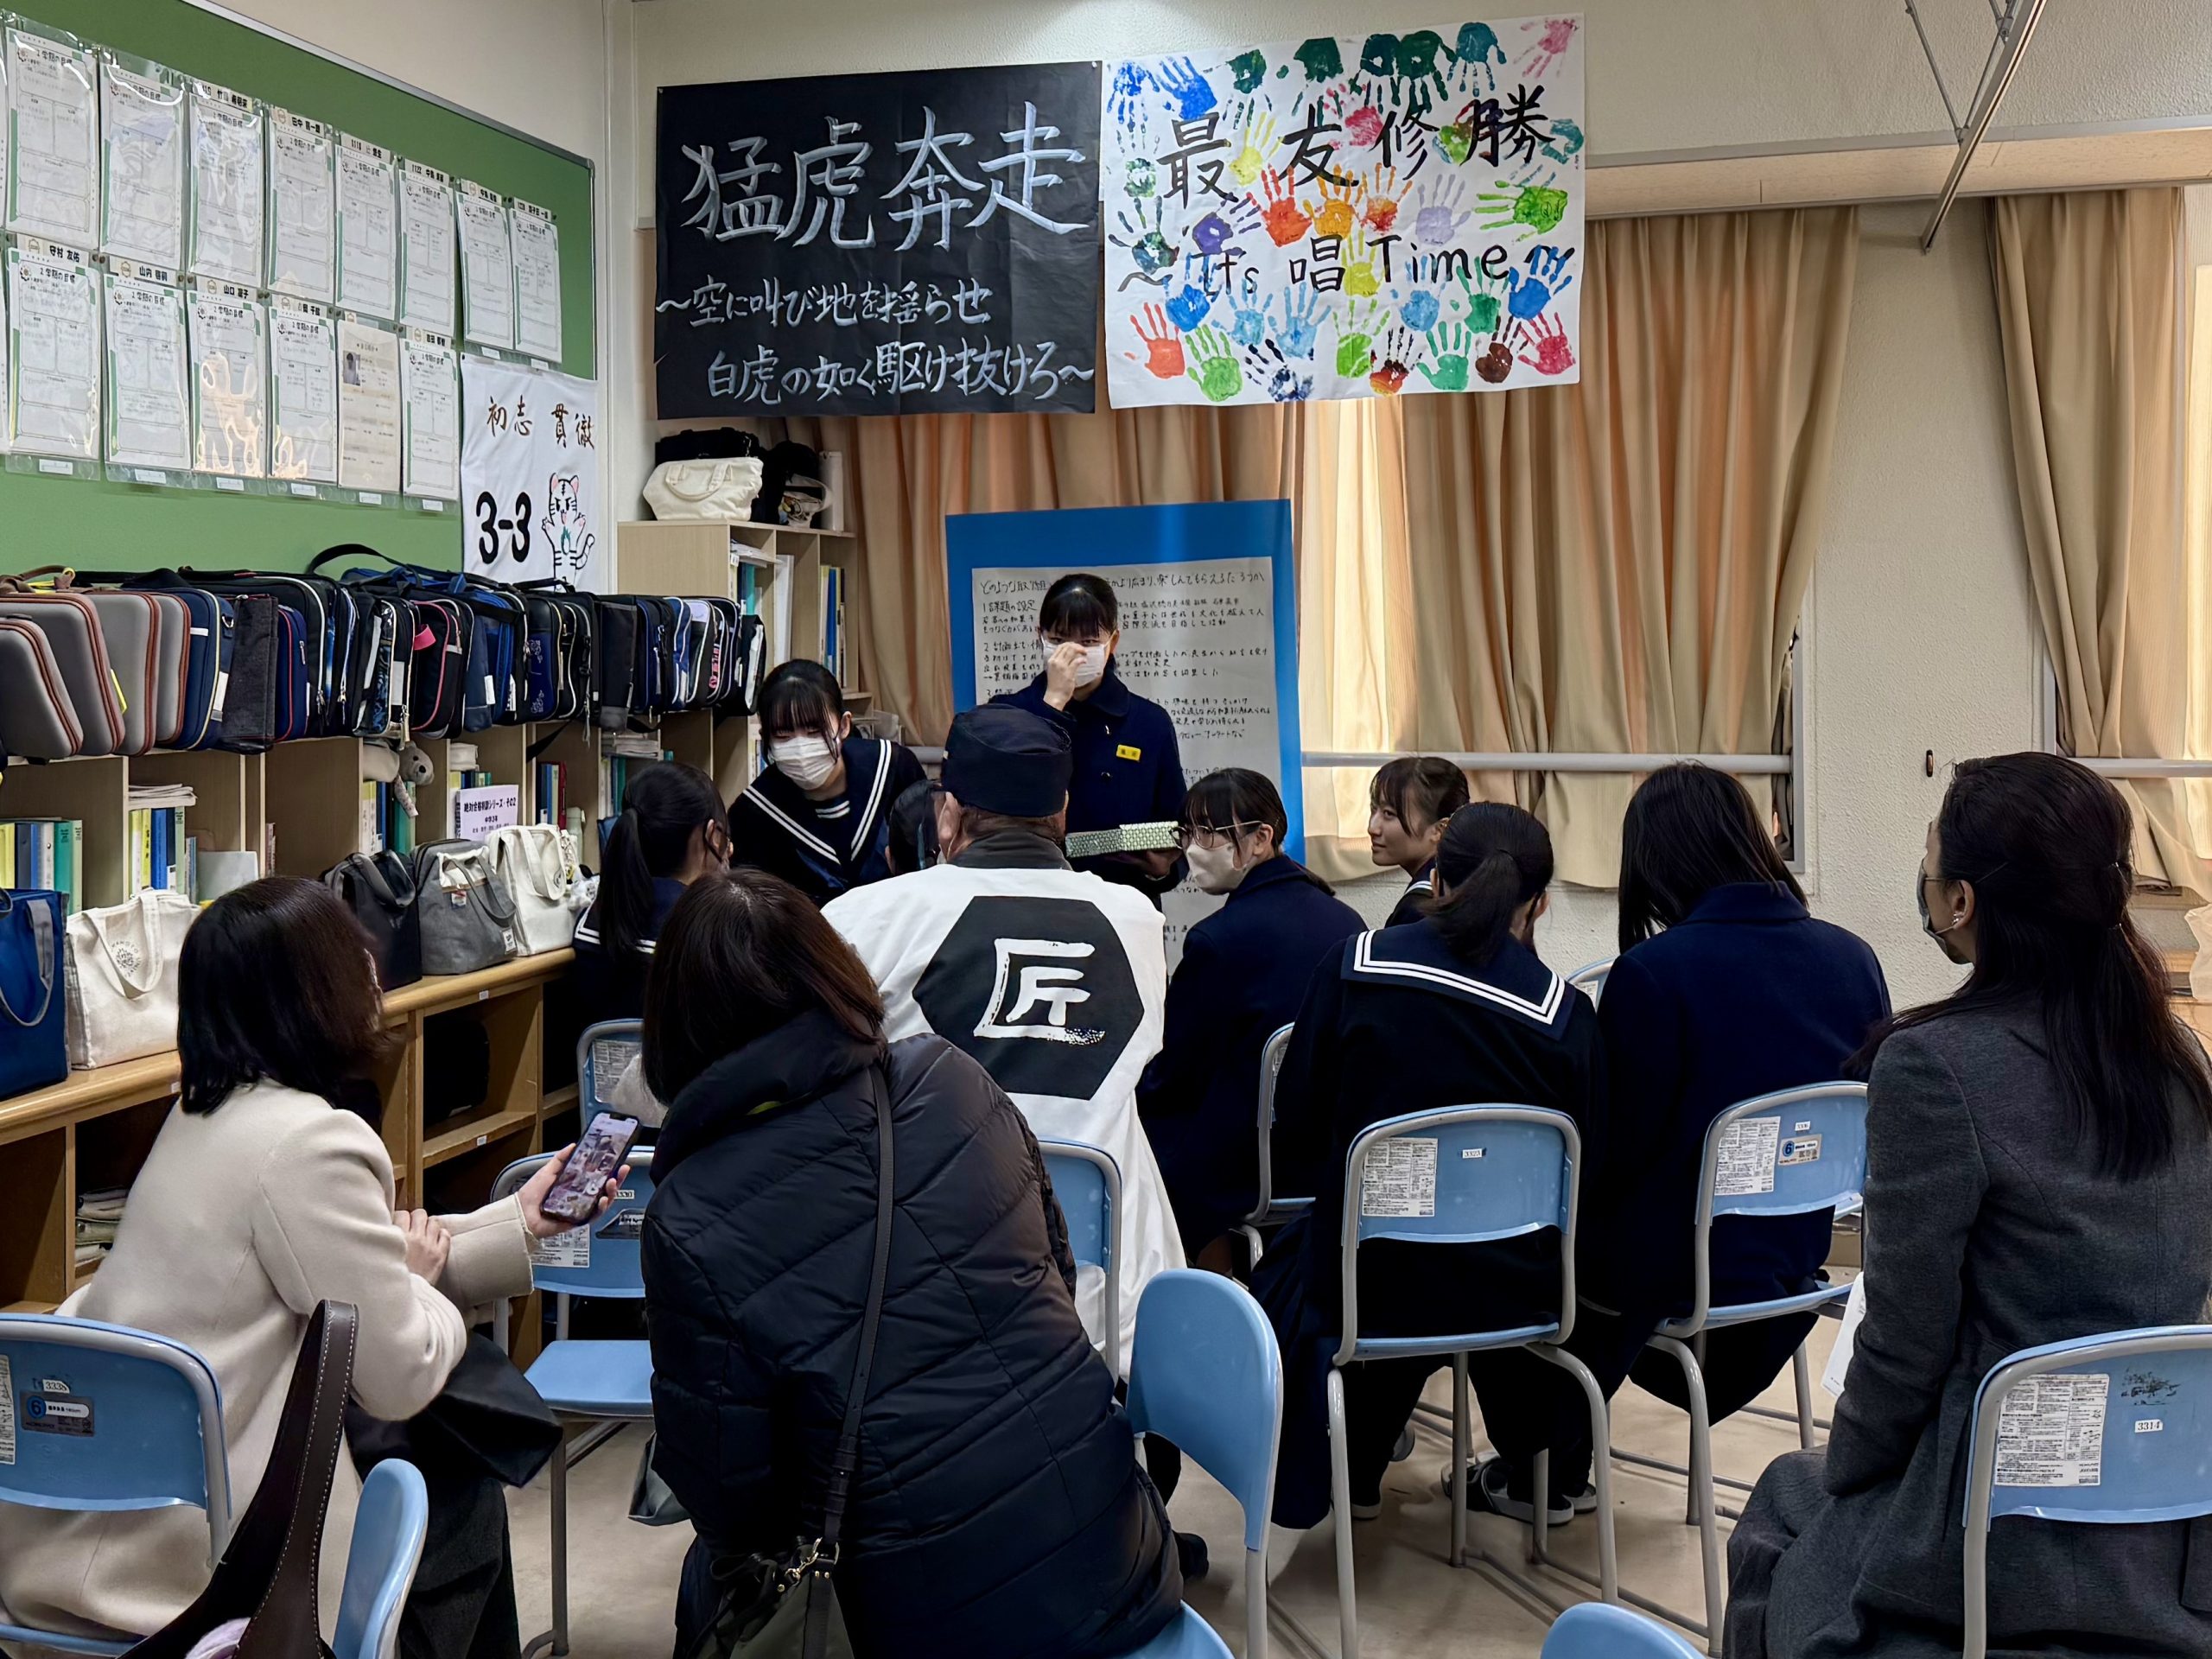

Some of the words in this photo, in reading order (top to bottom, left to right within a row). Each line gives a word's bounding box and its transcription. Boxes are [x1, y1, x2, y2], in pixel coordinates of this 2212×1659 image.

[680, 100, 1090, 251] 猛虎奔走
[1157, 84, 1554, 208] 最友修勝
[1289, 234, 1345, 293] 唱
[475, 492, 531, 564] 3-3
[973, 938, 1106, 1046] 匠
[2137, 1421, 2160, 1431] 3314
